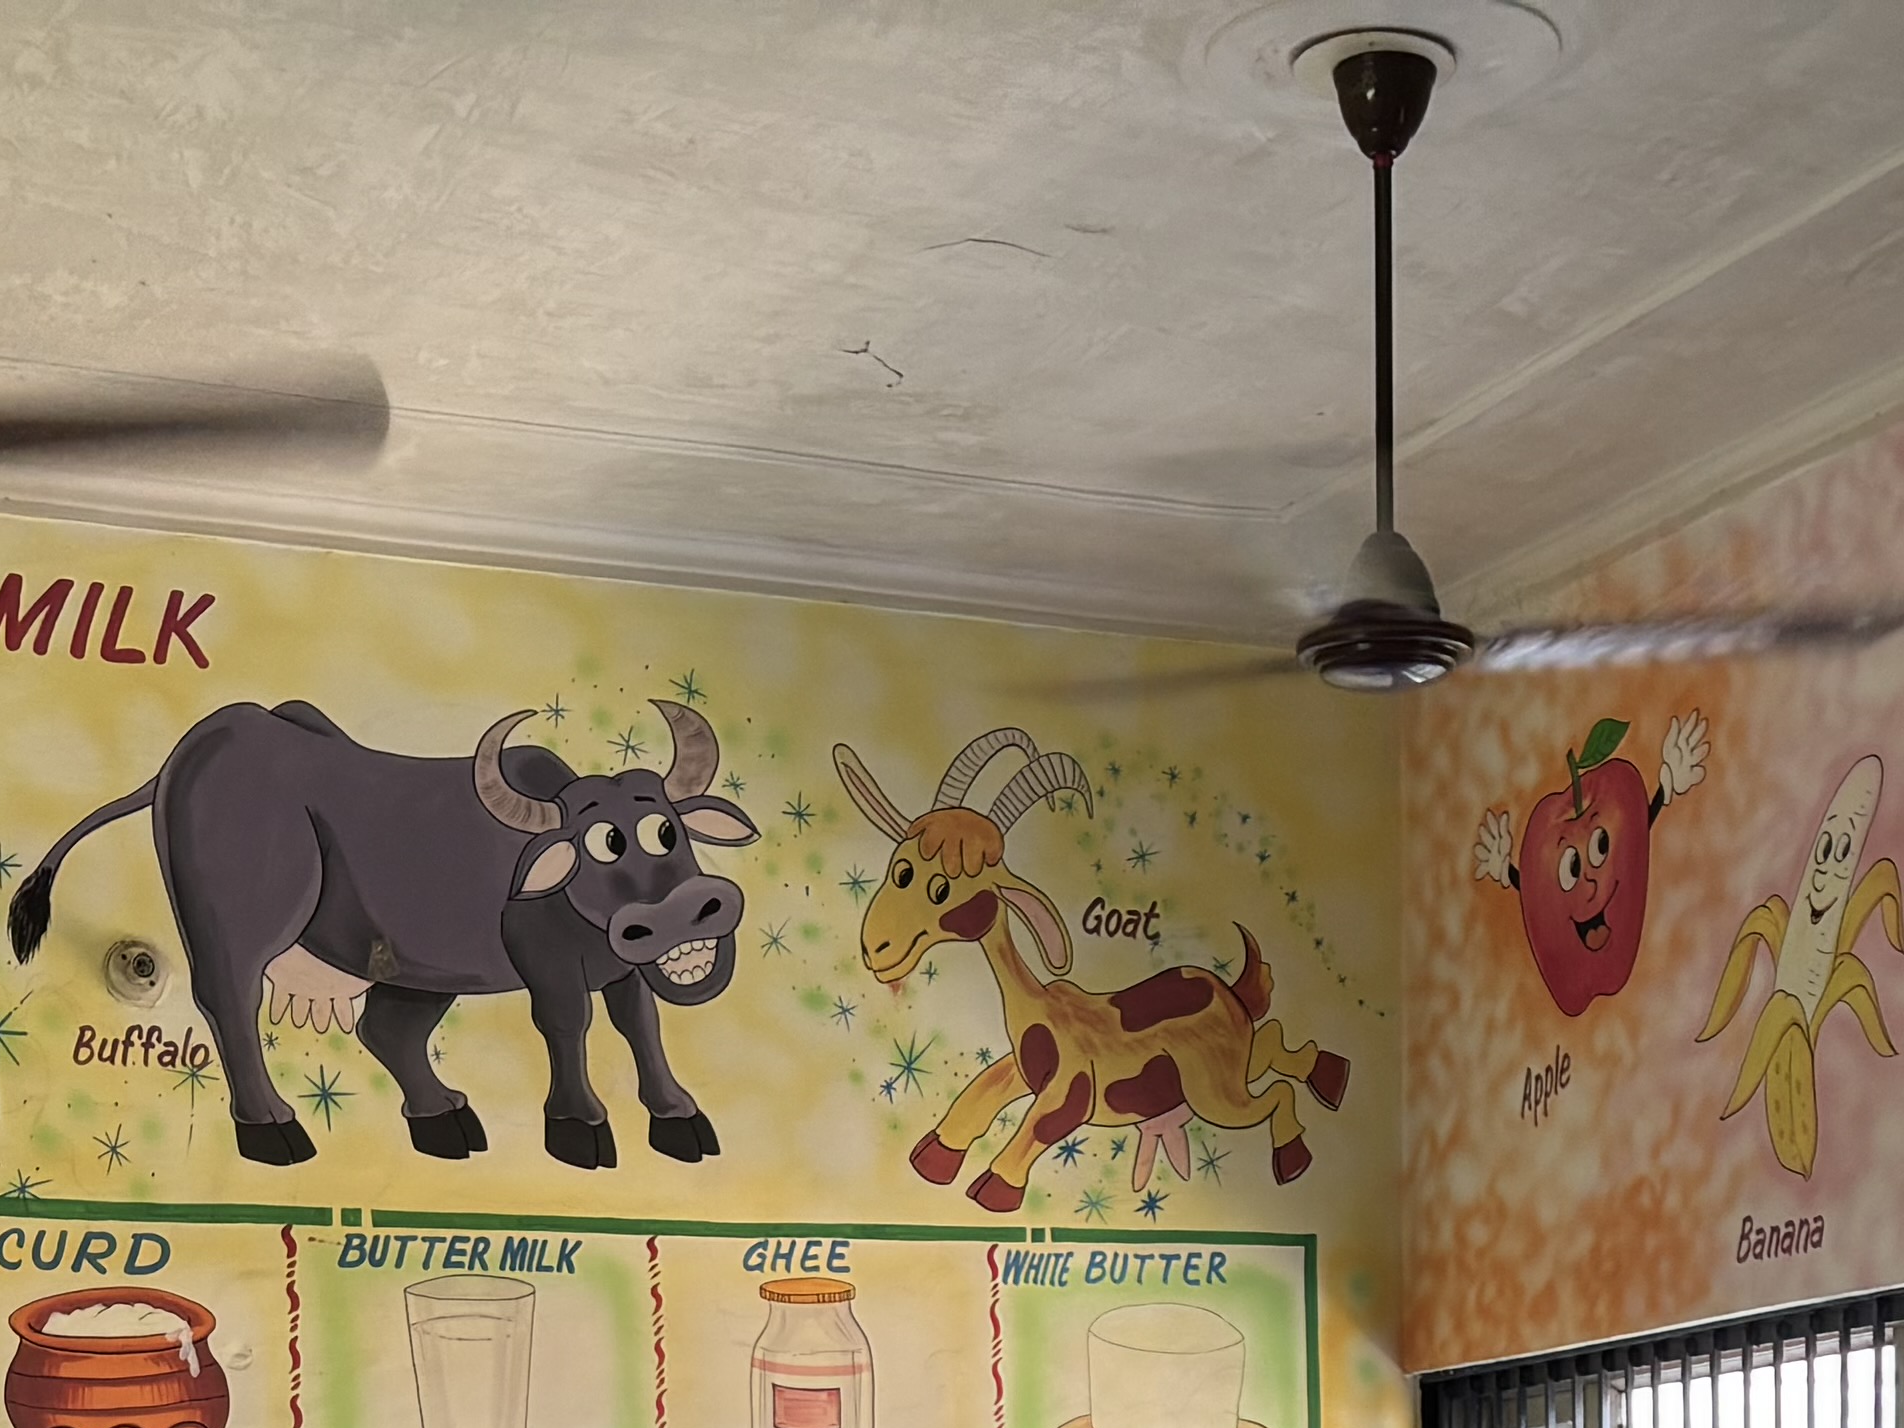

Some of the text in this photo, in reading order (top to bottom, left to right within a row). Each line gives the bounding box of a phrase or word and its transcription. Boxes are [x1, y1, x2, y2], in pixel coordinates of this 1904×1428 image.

[1082, 897, 1161, 941] Goat
[73, 1024, 210, 1068] Buffalo
[1521, 1044, 1571, 1127] Apple
[337, 1233, 583, 1274] BUTTER MILK
[742, 1239, 851, 1274] GHEE
[1735, 1215, 1825, 1265] Banana
[1002, 1249, 1228, 1286] WHITE BUTTER
